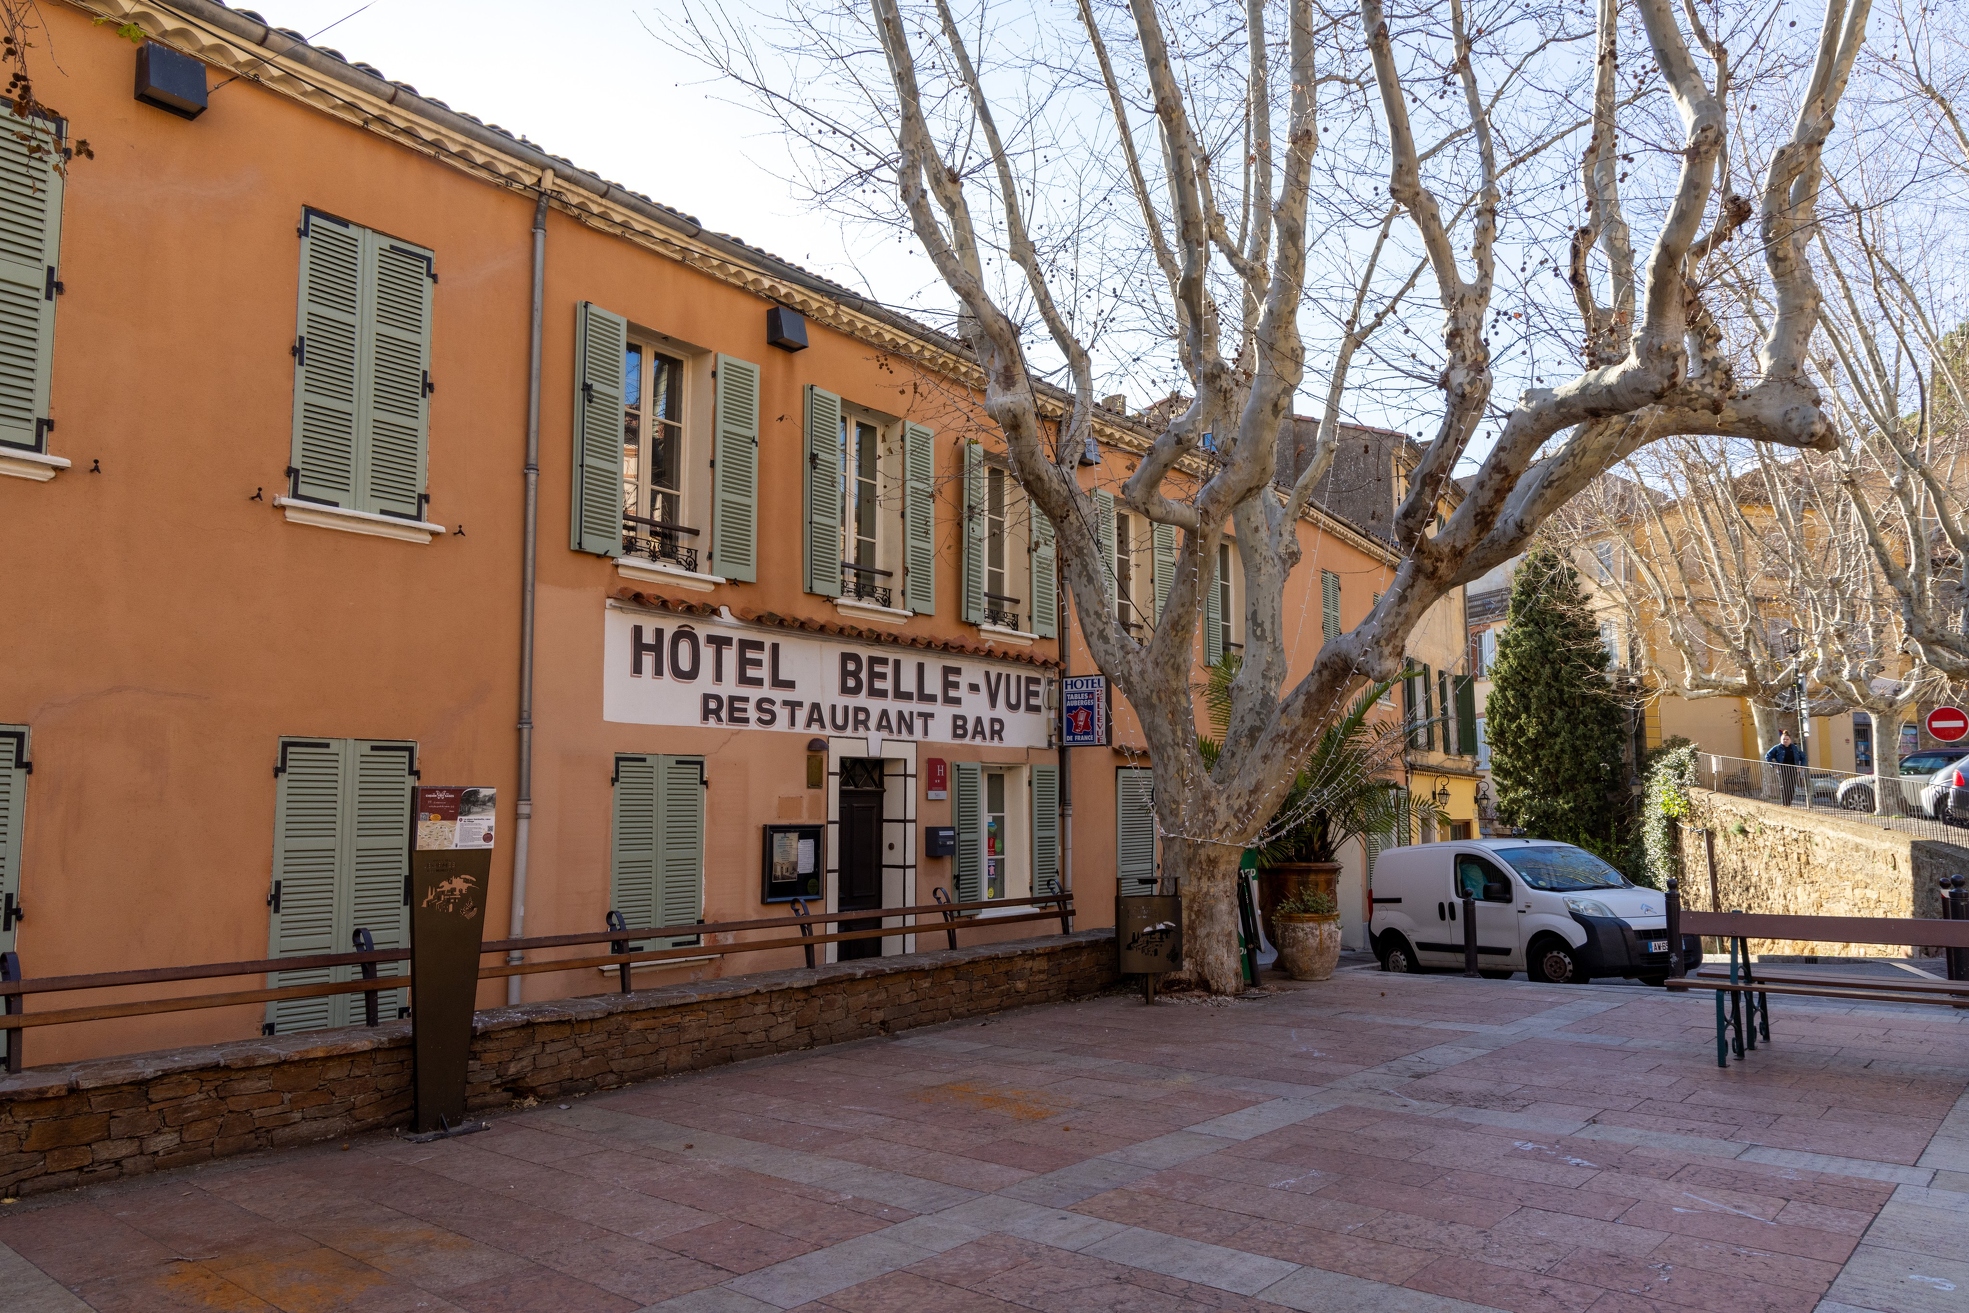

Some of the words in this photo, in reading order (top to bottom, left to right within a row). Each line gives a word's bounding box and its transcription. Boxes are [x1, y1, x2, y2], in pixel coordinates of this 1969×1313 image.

[631, 624, 797, 692] HÔTEL
[838, 652, 1043, 714] BELLE-VUE
[1065, 679, 1104, 690] HOTEL
[702, 693, 935, 737] RESTAURANT
[950, 714, 1006, 743] BAR
[937, 765, 945, 776] H
